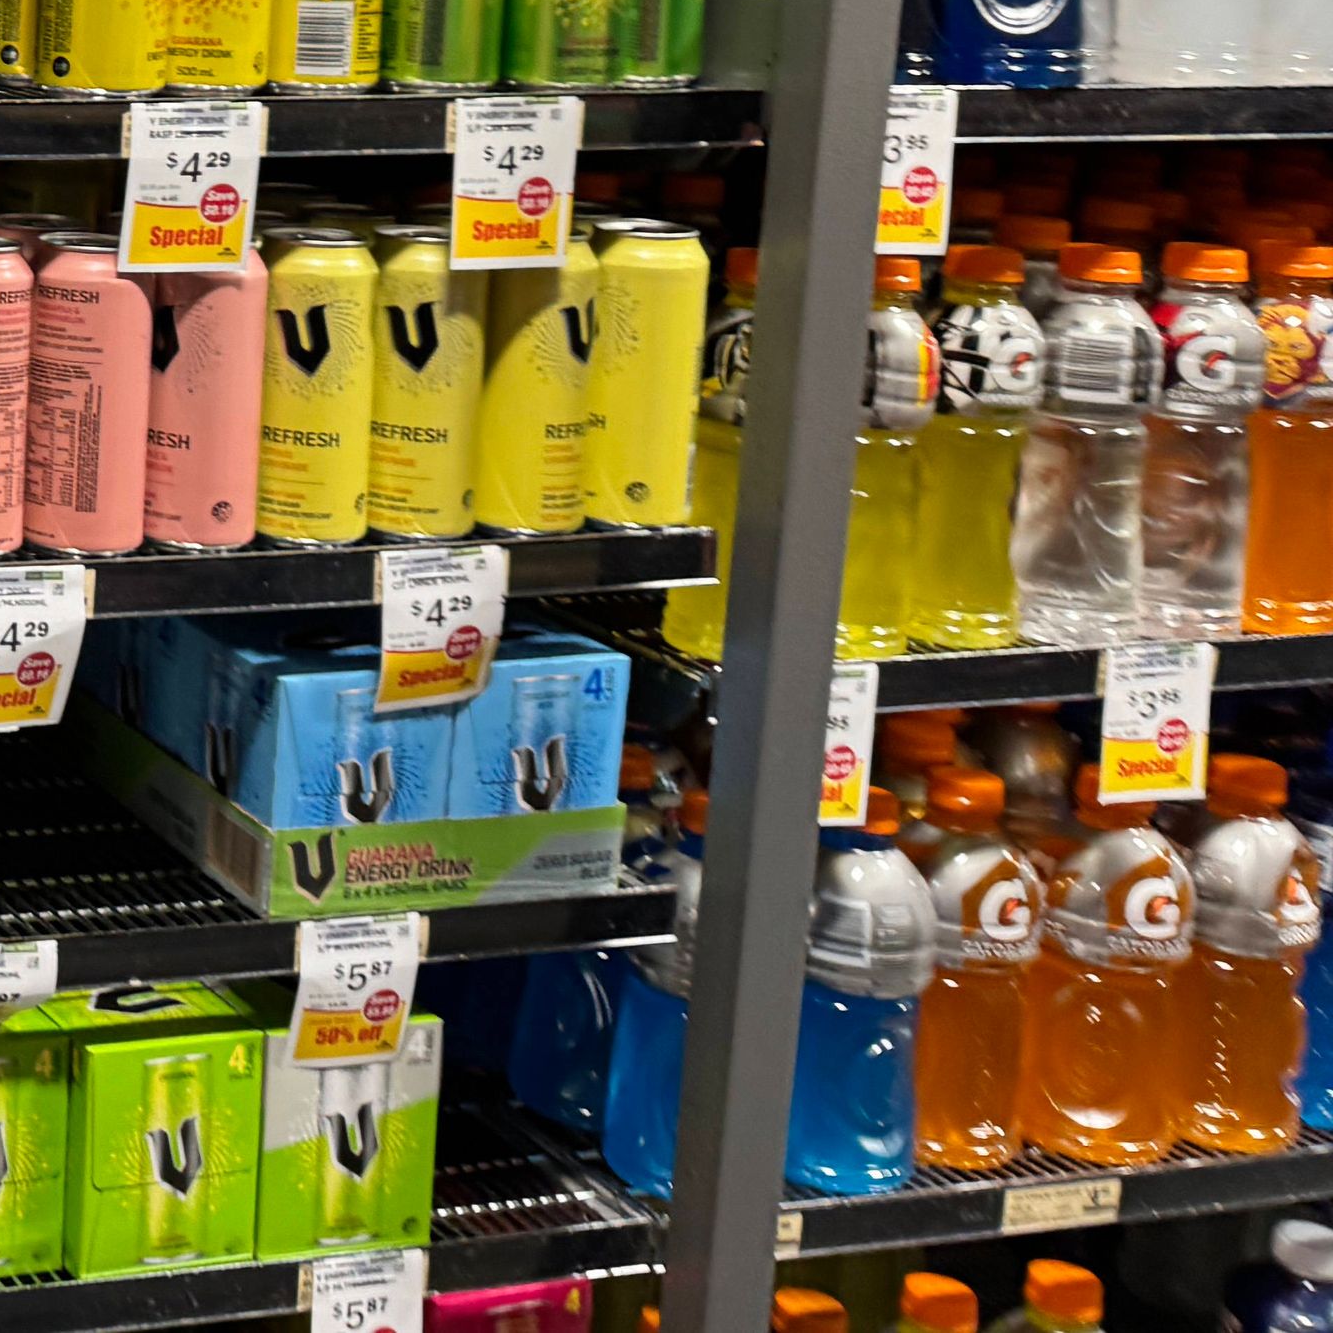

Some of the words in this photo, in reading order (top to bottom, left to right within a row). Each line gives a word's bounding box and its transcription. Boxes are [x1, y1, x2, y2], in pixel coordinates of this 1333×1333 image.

[149, 224, 224, 250] Special
[472, 218, 540, 243] Special
[262, 429, 340, 449] REFRESH
[369, 428, 449, 446] REFRESH
[344, 862, 413, 885] ENERGY
